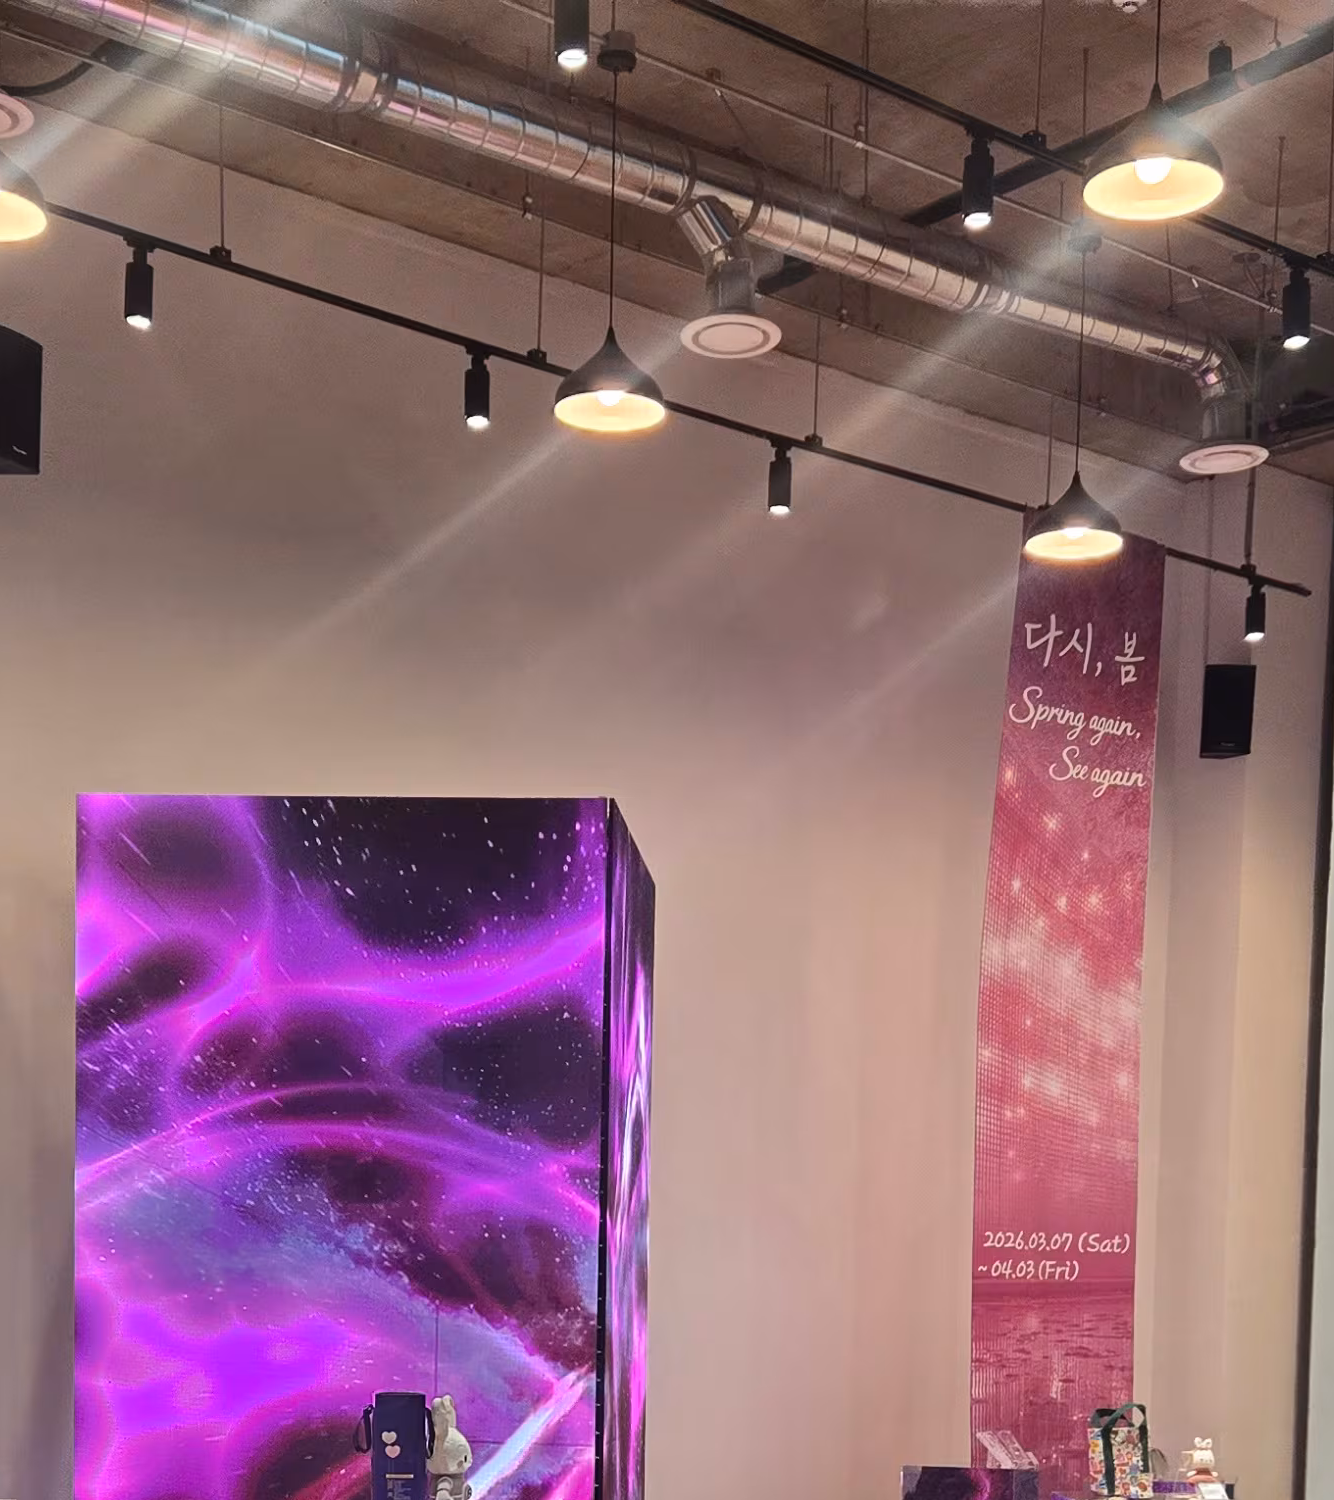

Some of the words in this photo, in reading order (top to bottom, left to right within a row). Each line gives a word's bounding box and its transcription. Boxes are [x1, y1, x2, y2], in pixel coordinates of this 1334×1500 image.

[1024, 613, 1103, 677] 다시,
[1114, 631, 1146, 686] 봄
[1008, 686, 1087, 740] Spring
[1089, 716, 1142, 746] again,
[1049, 746, 1087, 781] See
[1091, 769, 1147, 798] again
[983, 1231, 1073, 1252] 2026.03.07
[1078, 1233, 1131, 1254] (Sat)
[991, 1260, 1034, 1279] 04.03
[1038, 1261, 1080, 1281] (Fri)
